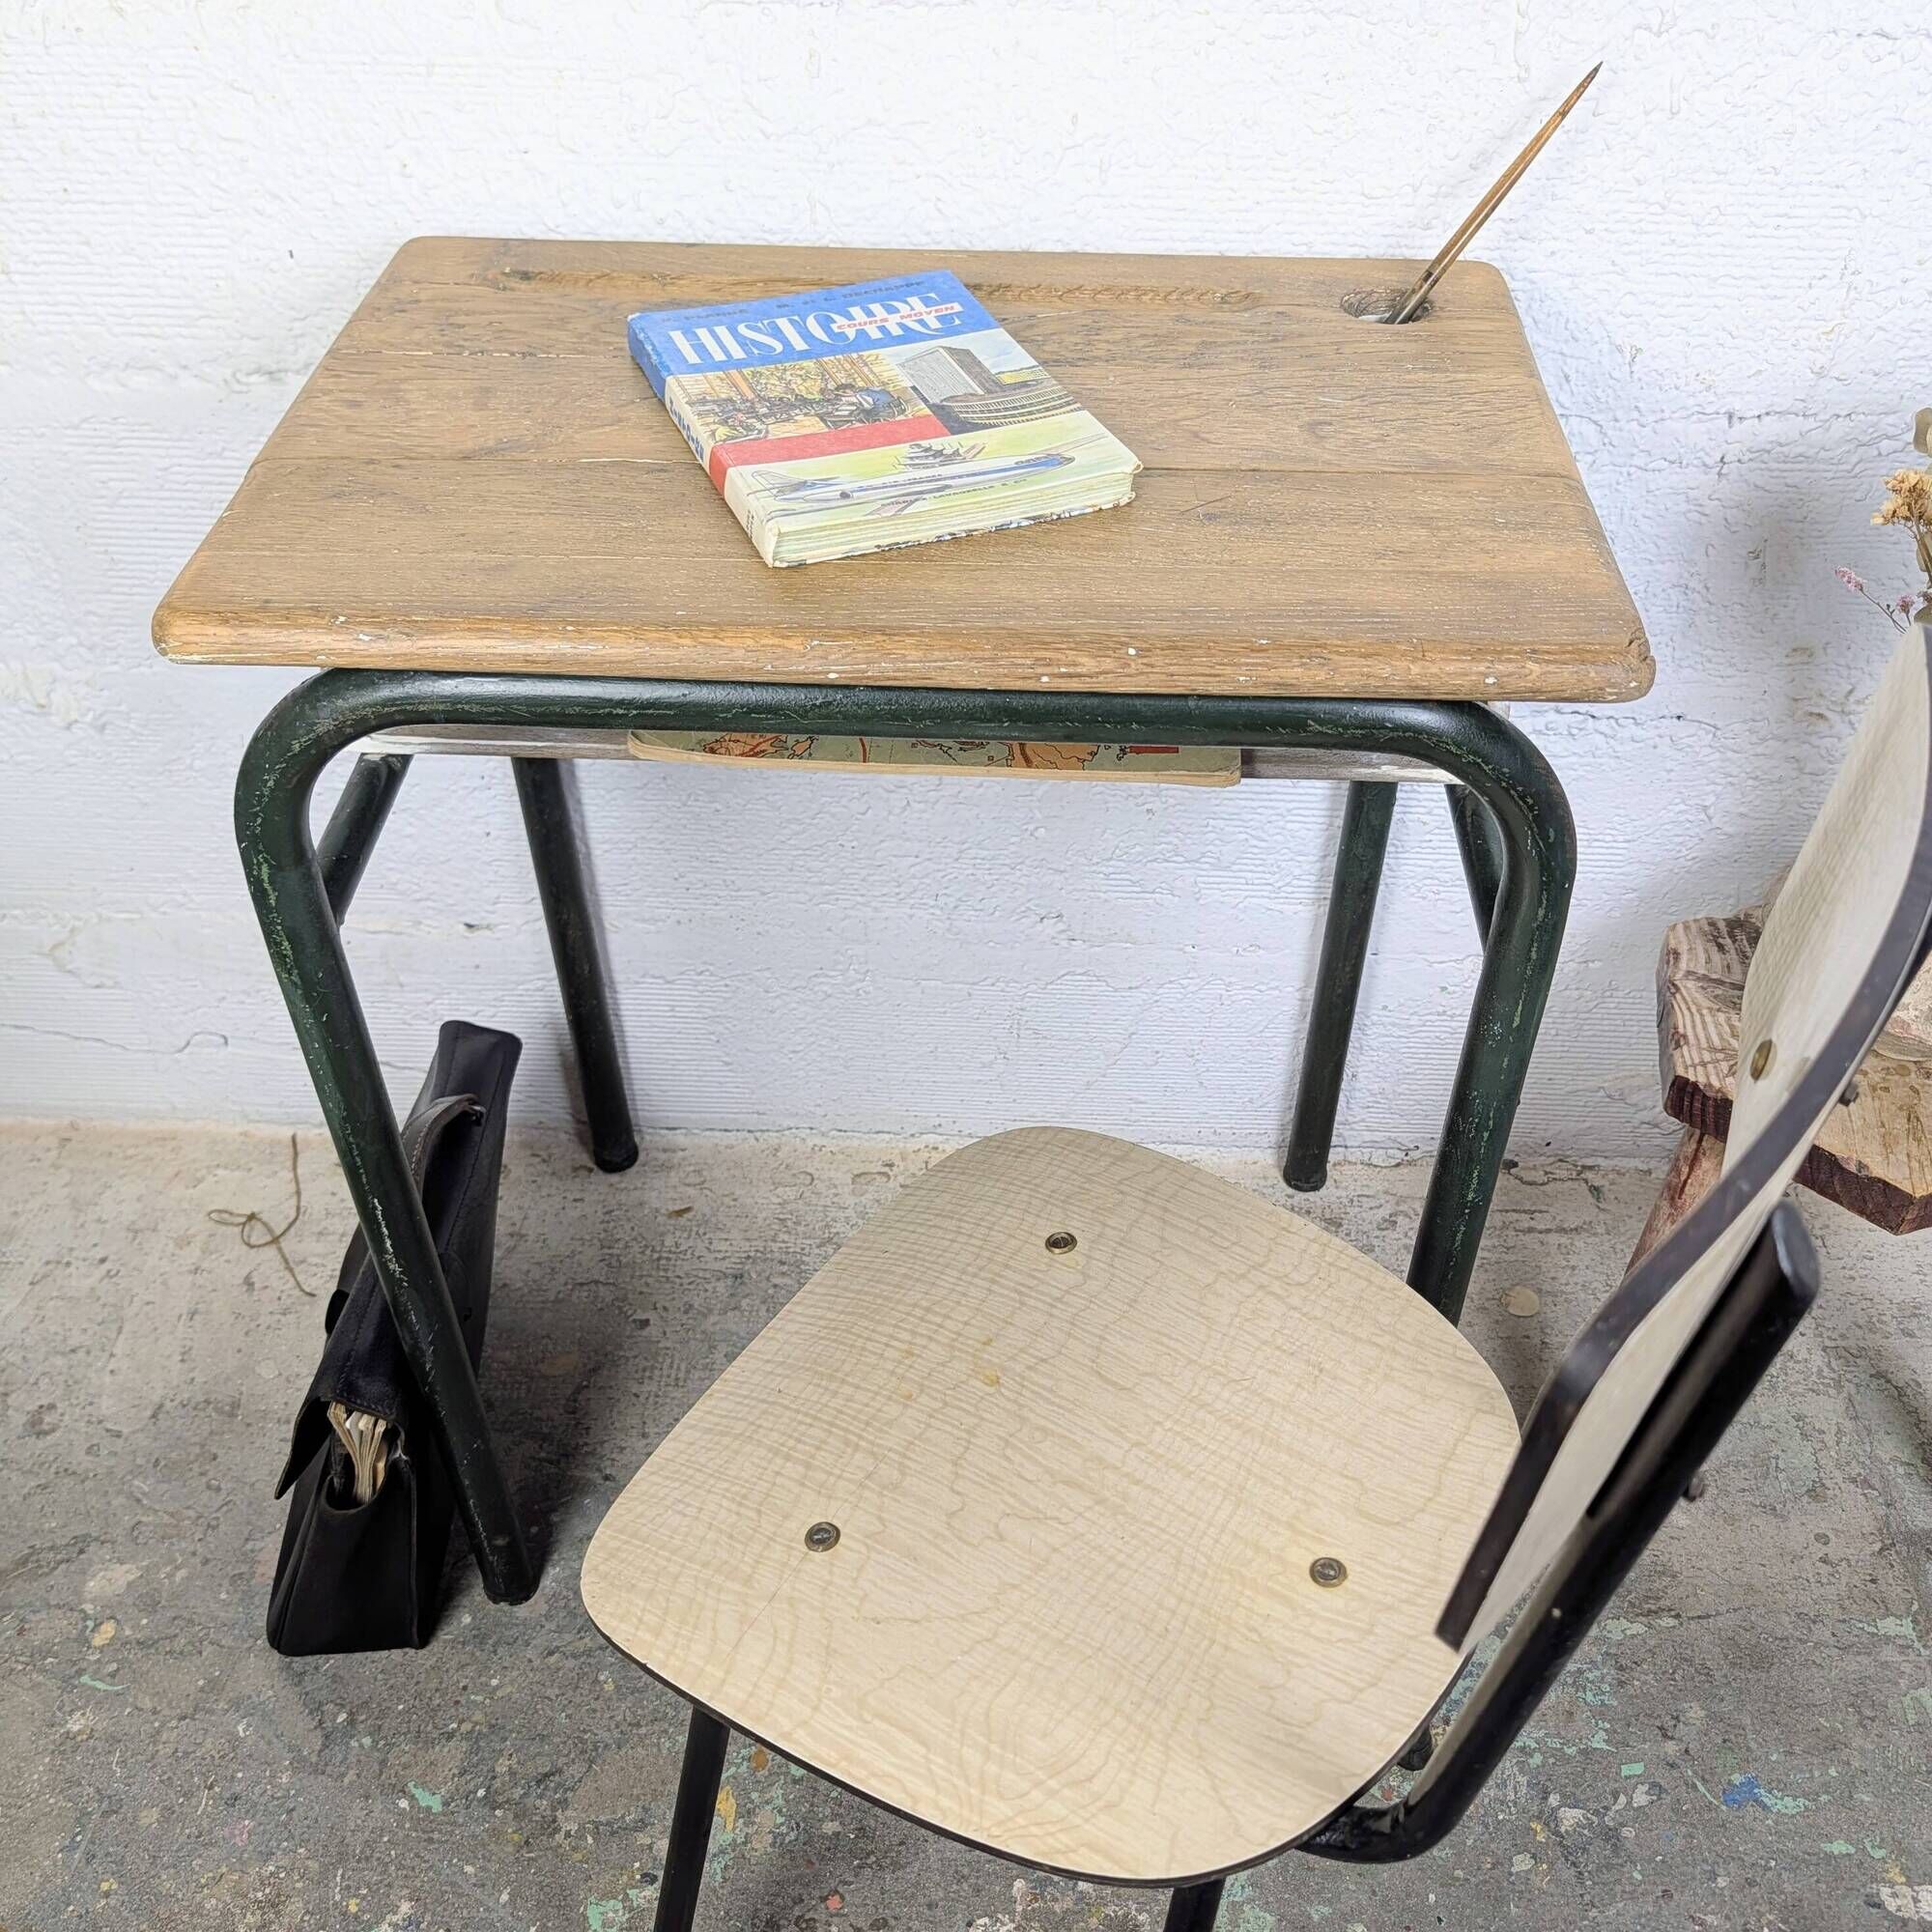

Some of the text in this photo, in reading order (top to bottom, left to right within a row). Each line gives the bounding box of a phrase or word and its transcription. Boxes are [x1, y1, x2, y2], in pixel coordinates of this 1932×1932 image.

[668, 293, 961, 364] HISTOIRE
[836, 304, 955, 331] COURS MOYEN
